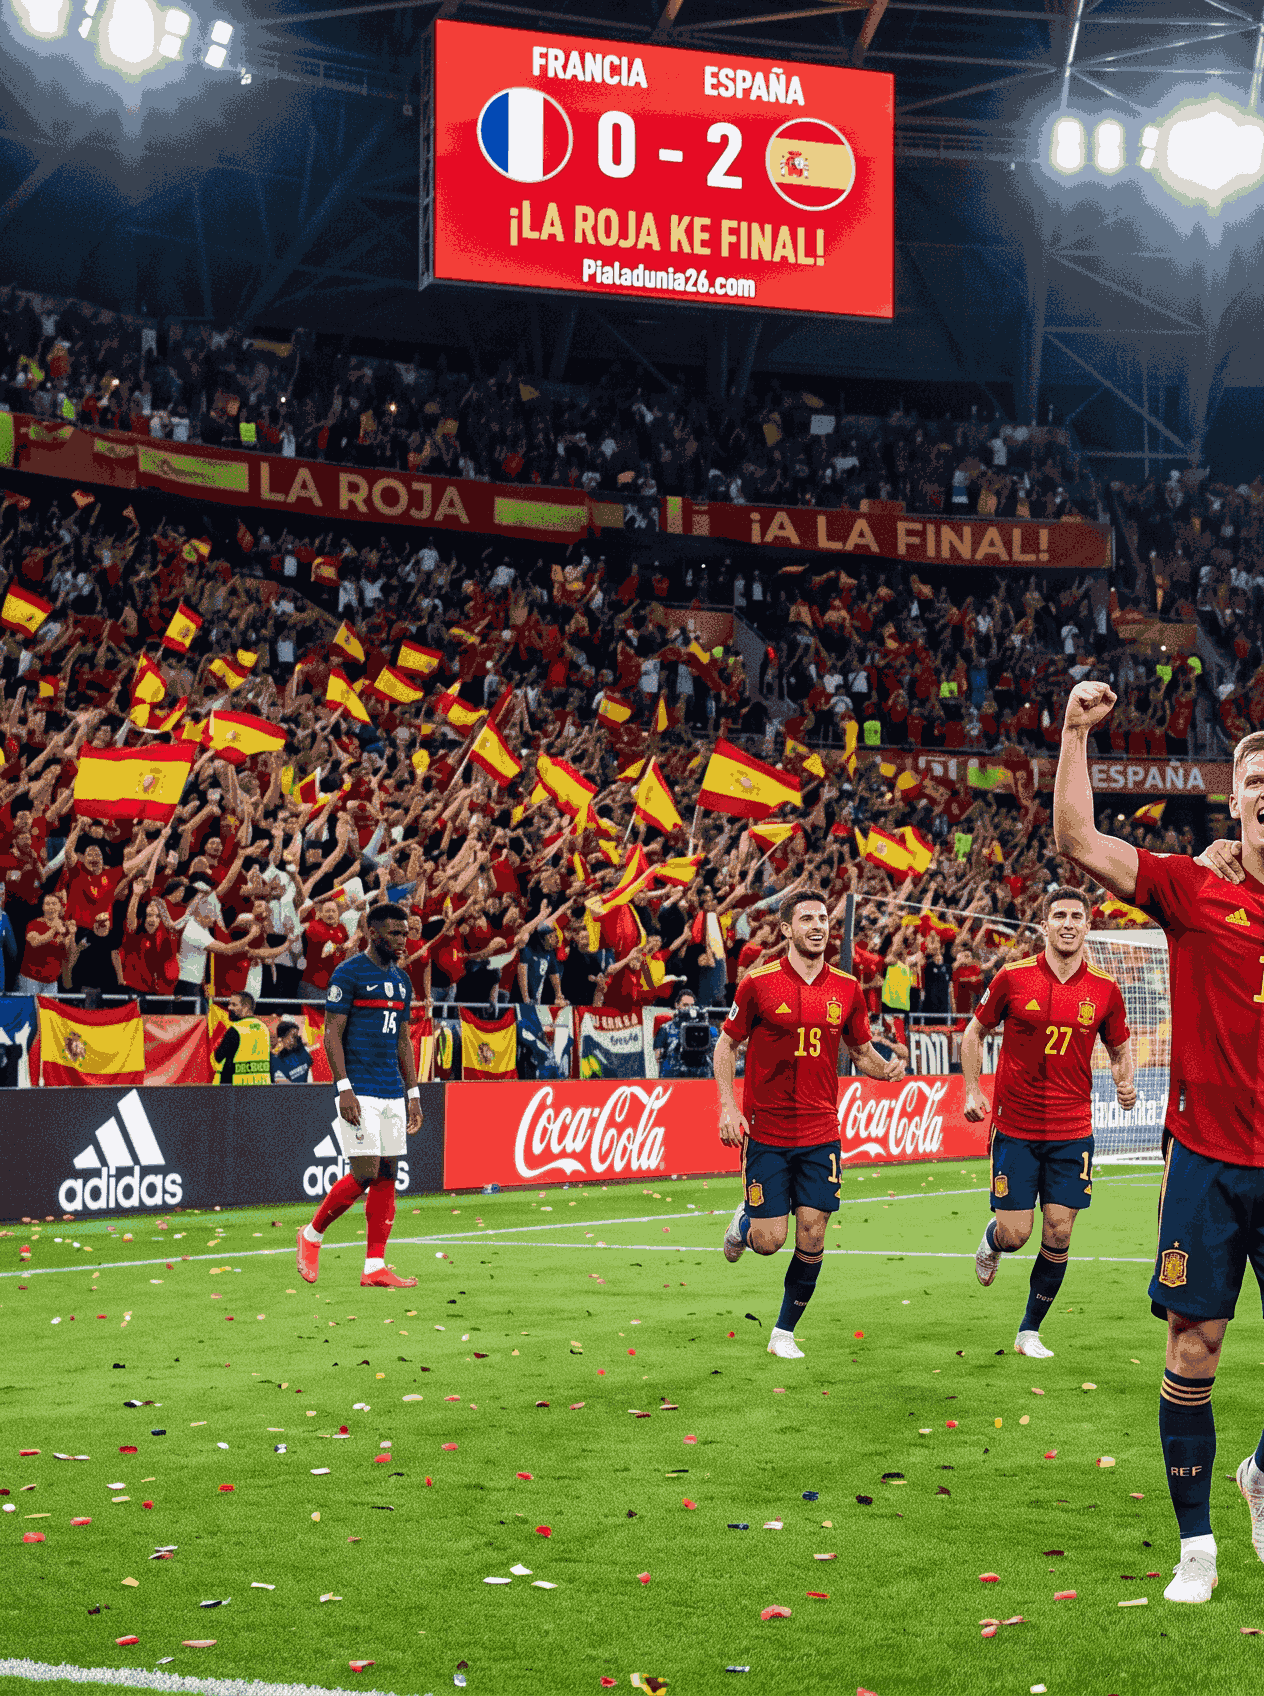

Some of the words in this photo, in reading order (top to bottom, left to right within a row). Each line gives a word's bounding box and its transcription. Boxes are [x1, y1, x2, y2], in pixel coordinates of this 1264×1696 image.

[532, 46, 648, 89] FRANCIA
[703, 66, 805, 106] ESPAÑA
[598, 110, 636, 179] 0
[706, 122, 743, 190] 2
[509, 200, 565, 247] ¡LA
[574, 204, 661, 252] ROJA
[670, 215, 712, 256] KE
[721, 219, 825, 267] FINAL!
[582, 258, 756, 299] Pialadunia26.com
[259, 460, 323, 509] LA
[338, 472, 471, 526] ROJA
[750, 510, 801, 547] ¡A
[816, 514, 880, 554] LA
[895, 521, 1051, 562] FINAL!
[1044, 1025, 1074, 1056] 27
[514, 1084, 673, 1179] Coca-Cola
[58, 1165, 184, 1212] adidas
[303, 1155, 410, 1197] adis
[1170, 1465, 1203, 1478] REF
